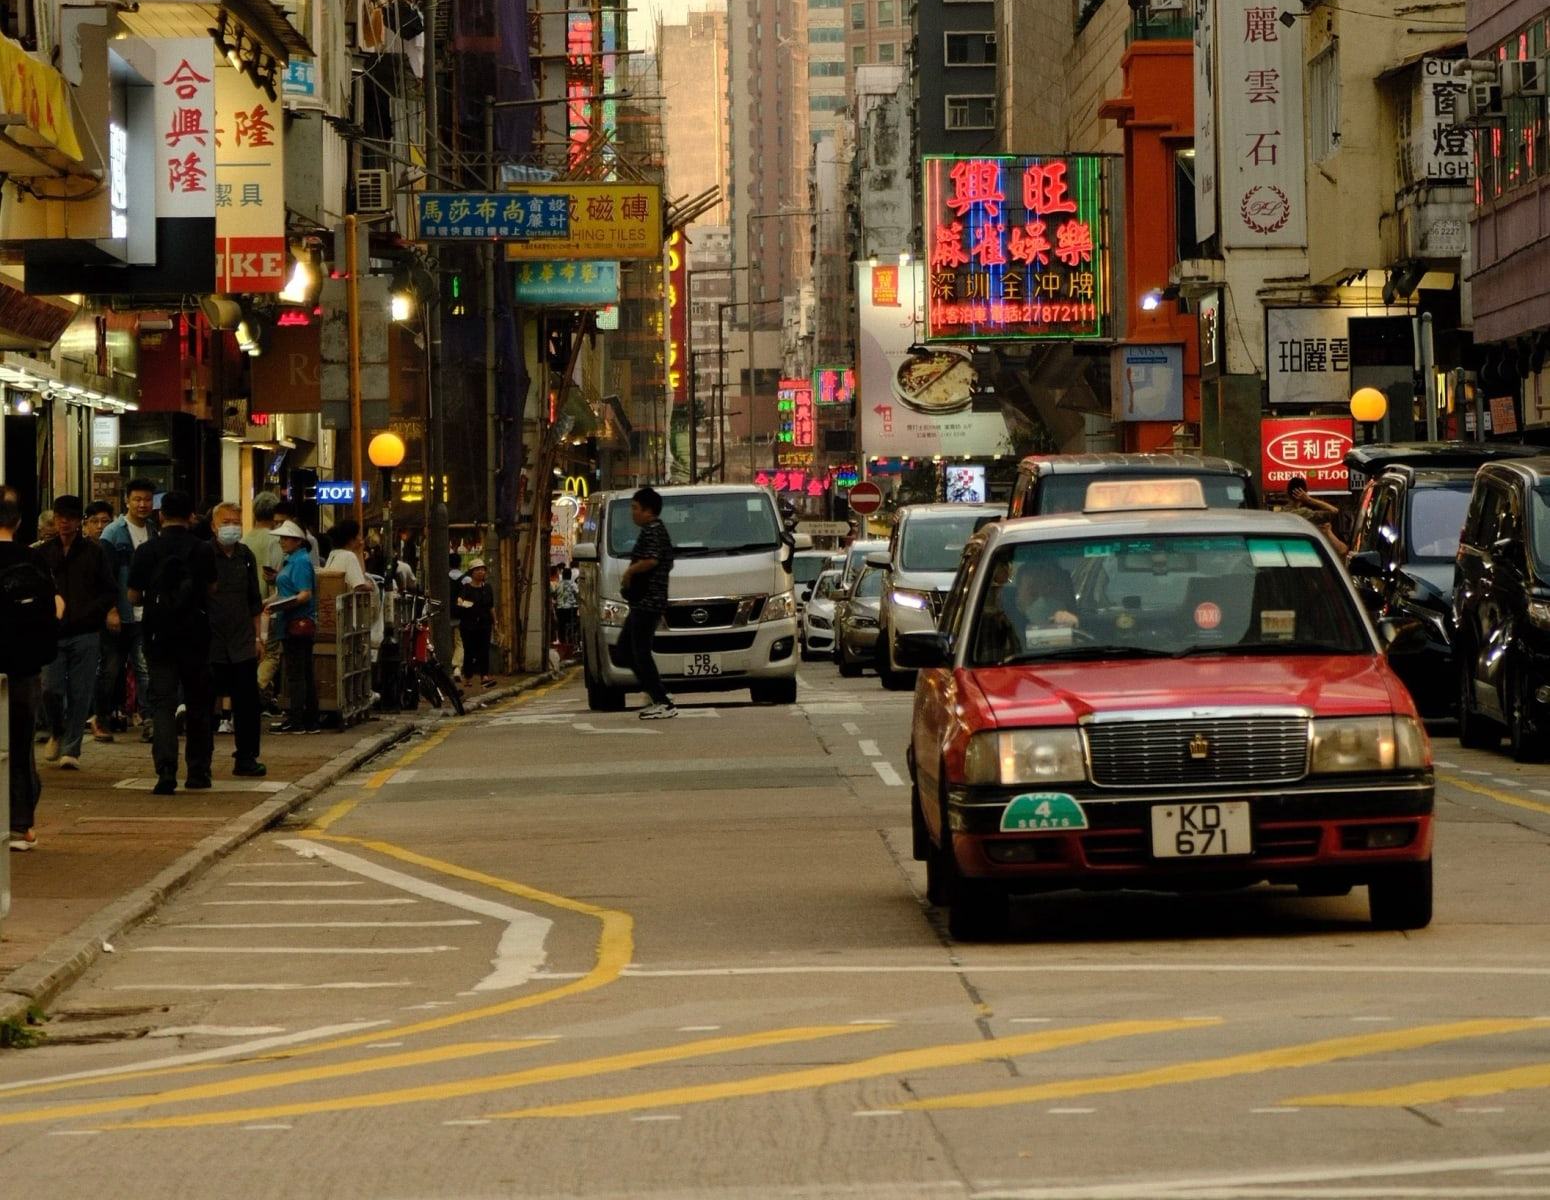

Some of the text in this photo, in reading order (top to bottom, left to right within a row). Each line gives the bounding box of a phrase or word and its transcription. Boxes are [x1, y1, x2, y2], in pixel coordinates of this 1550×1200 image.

[1426, 62, 1452, 76] CU
[163, 59, 210, 194] 合興隆
[1427, 161, 1474, 176] LIGH
[947, 162, 1077, 216] 興旺
[422, 198, 525, 224] 馬莎布尚
[572, 228, 646, 240] HING TILES
[931, 220, 1094, 267] 麻雀娛樂
[1279, 338, 1349, 373] 珀麗雲
[1281, 439, 1344, 460] 百利店
[1268, 470, 1307, 481] GREEN
[1318, 470, 1349, 480] FLOO
[1198, 609, 1220, 623] TAXI
[694, 653, 711, 665] PB
[688, 663, 719, 675] 3796
[1035, 801, 1051, 818] 4
[1180, 804, 1220, 831] KD
[1018, 818, 1070, 829] SEATS
[1175, 828, 1227, 855] 671
